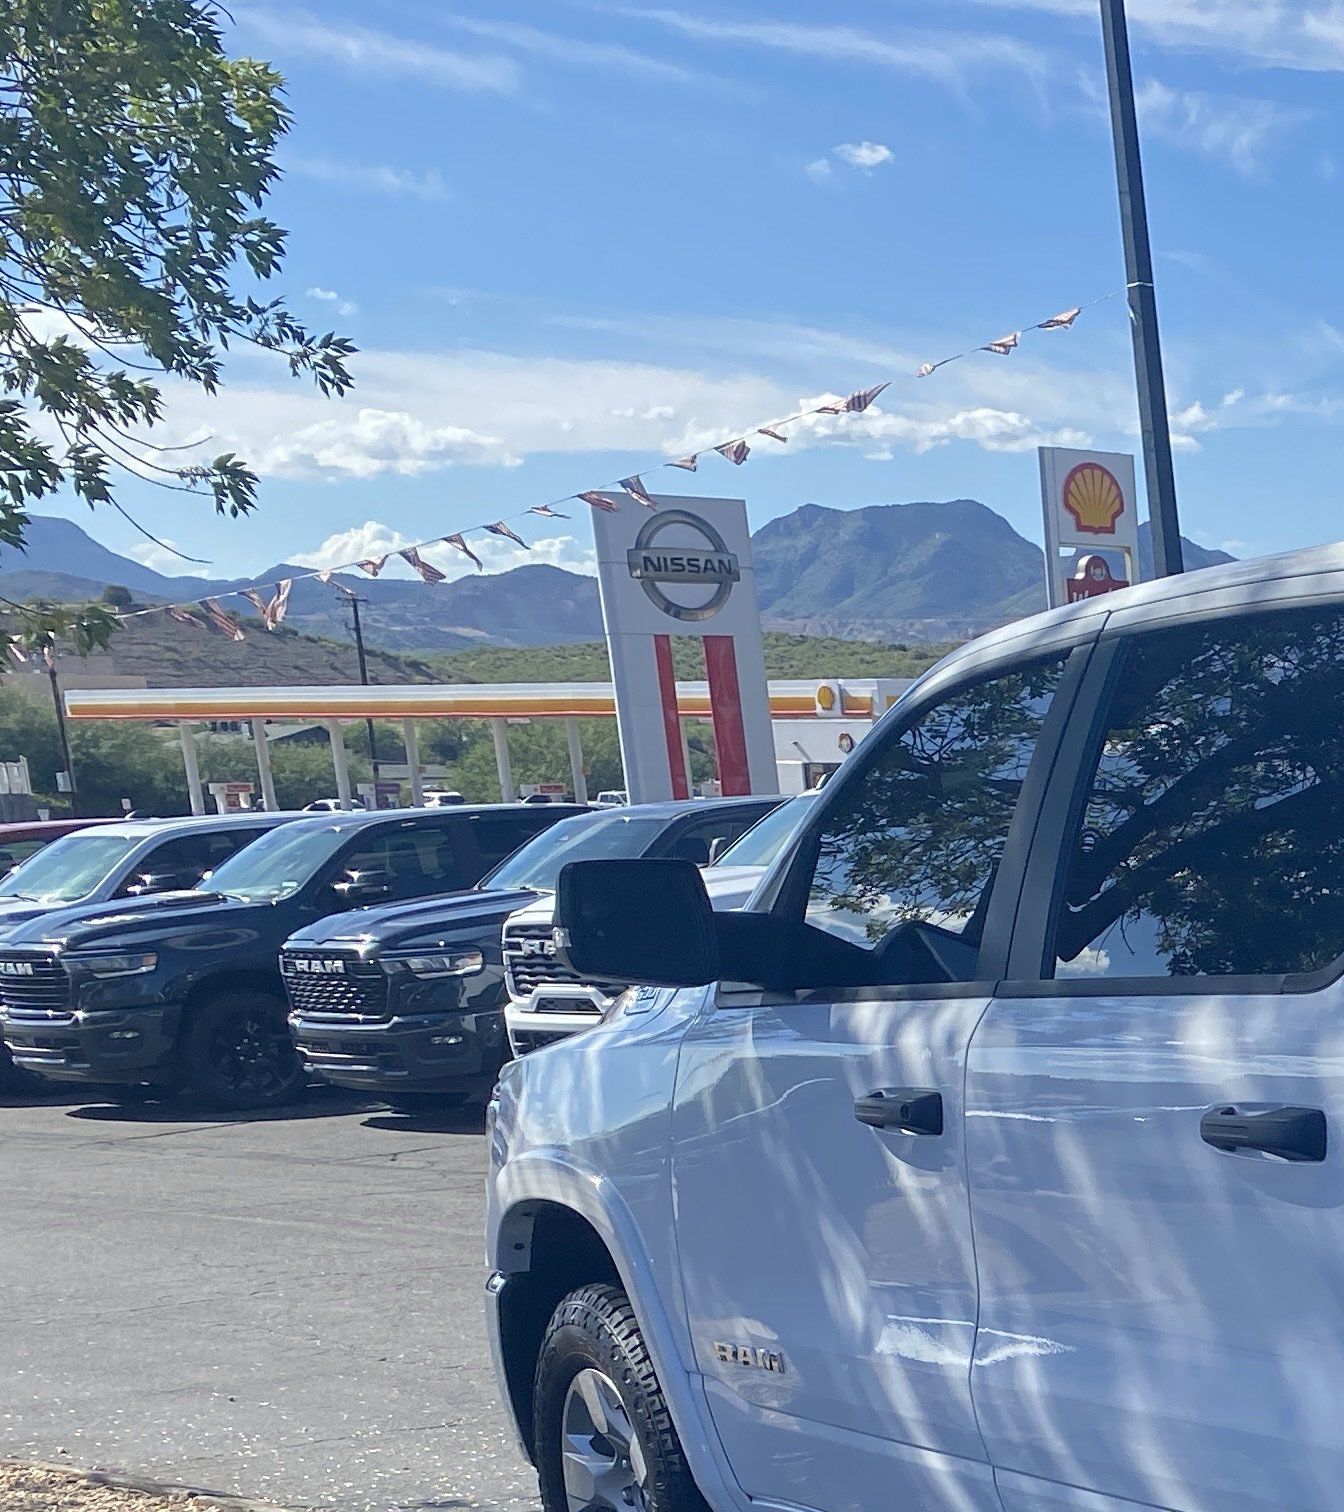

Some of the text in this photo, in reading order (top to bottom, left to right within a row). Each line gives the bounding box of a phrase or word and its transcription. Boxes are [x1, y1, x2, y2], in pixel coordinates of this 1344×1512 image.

[642, 556, 733, 575] NISSAN
[523, 939, 557, 955] RA
[294, 959, 346, 974] RAM
[713, 1341, 785, 1374] RAM
